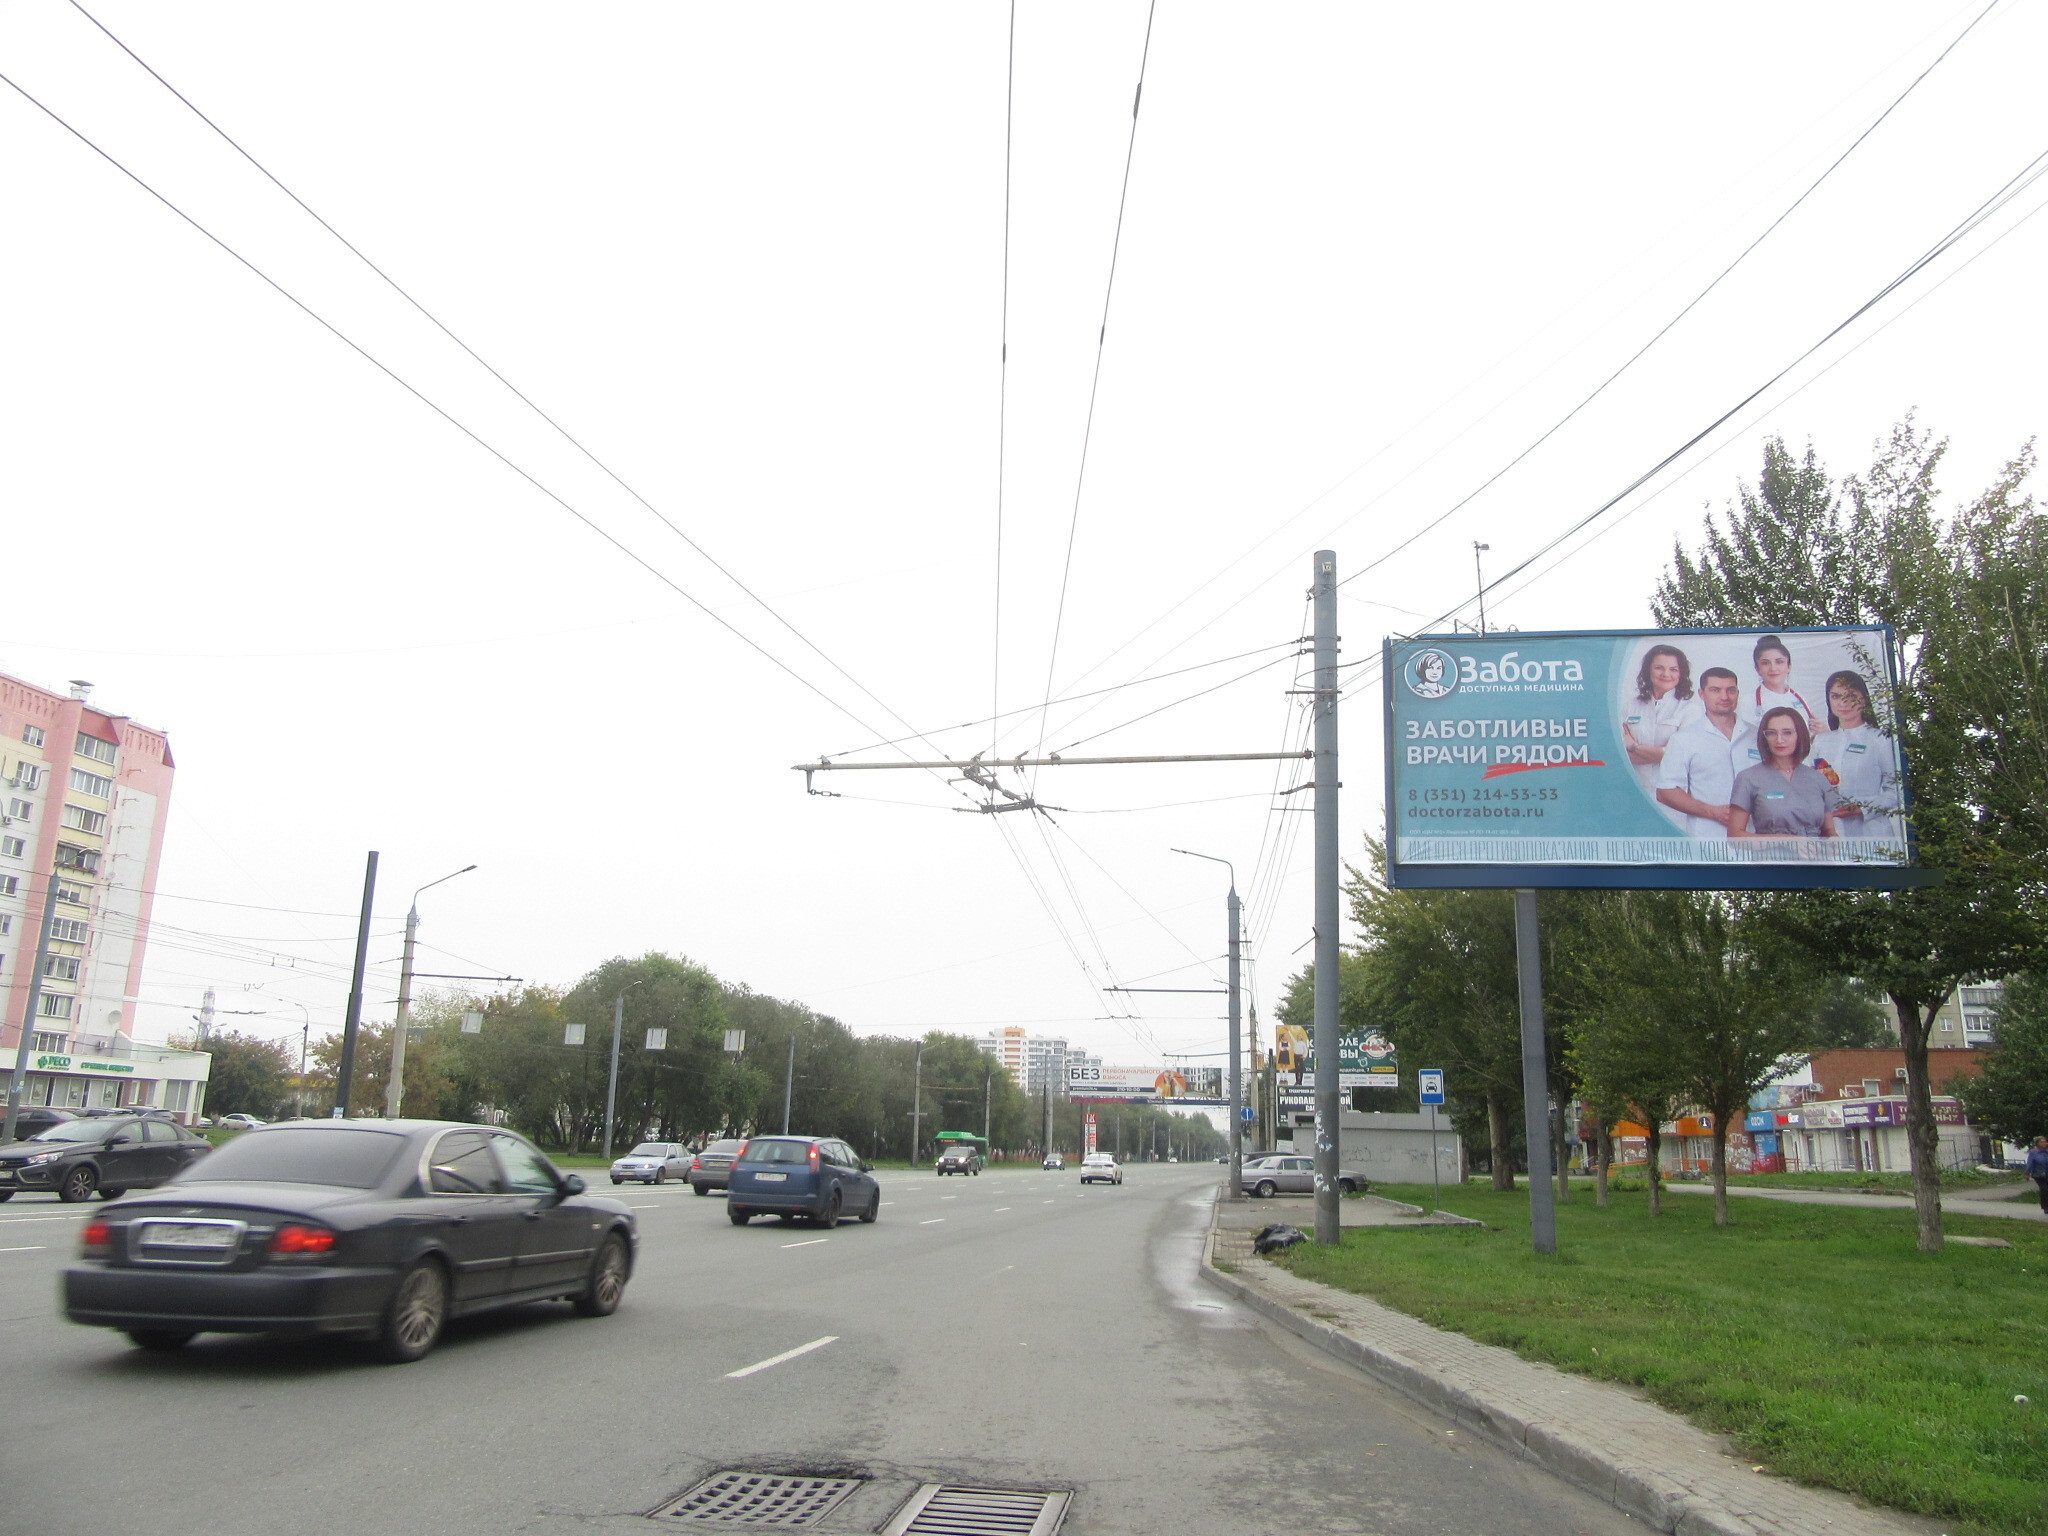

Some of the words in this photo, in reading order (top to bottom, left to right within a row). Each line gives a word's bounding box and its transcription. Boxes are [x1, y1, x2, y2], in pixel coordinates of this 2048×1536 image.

[1458, 652, 1585, 683] Забота
[1458, 684, 1521, 694] ДОСТУПНАЯ
[1524, 683, 1585, 693] МЕДИЦИНА
[1405, 718, 1589, 739] ЗАБОТЛИВЫЕ
[1406, 745, 1488, 765] ВРАЧИ
[1495, 744, 1590, 767] РЯДОМ
[1408, 789, 1418, 801] 8
[1424, 788, 1467, 803] (351)
[1472, 788, 1559, 801] 214-53-53
[1408, 806, 1545, 818] doctorzabota.ru
[1408, 841, 1467, 861] ИМЕЮТСЯ
[1470, 841, 1600, 861] ПРОТИВОПОКАЗАНИЯ
[1606, 841, 1693, 862] НЕОБХОДИМА
[1700, 841, 1800, 862] КОНСУЛЬТАЦИЯ
[1070, 1068, 1100, 1080] БЕЗ
